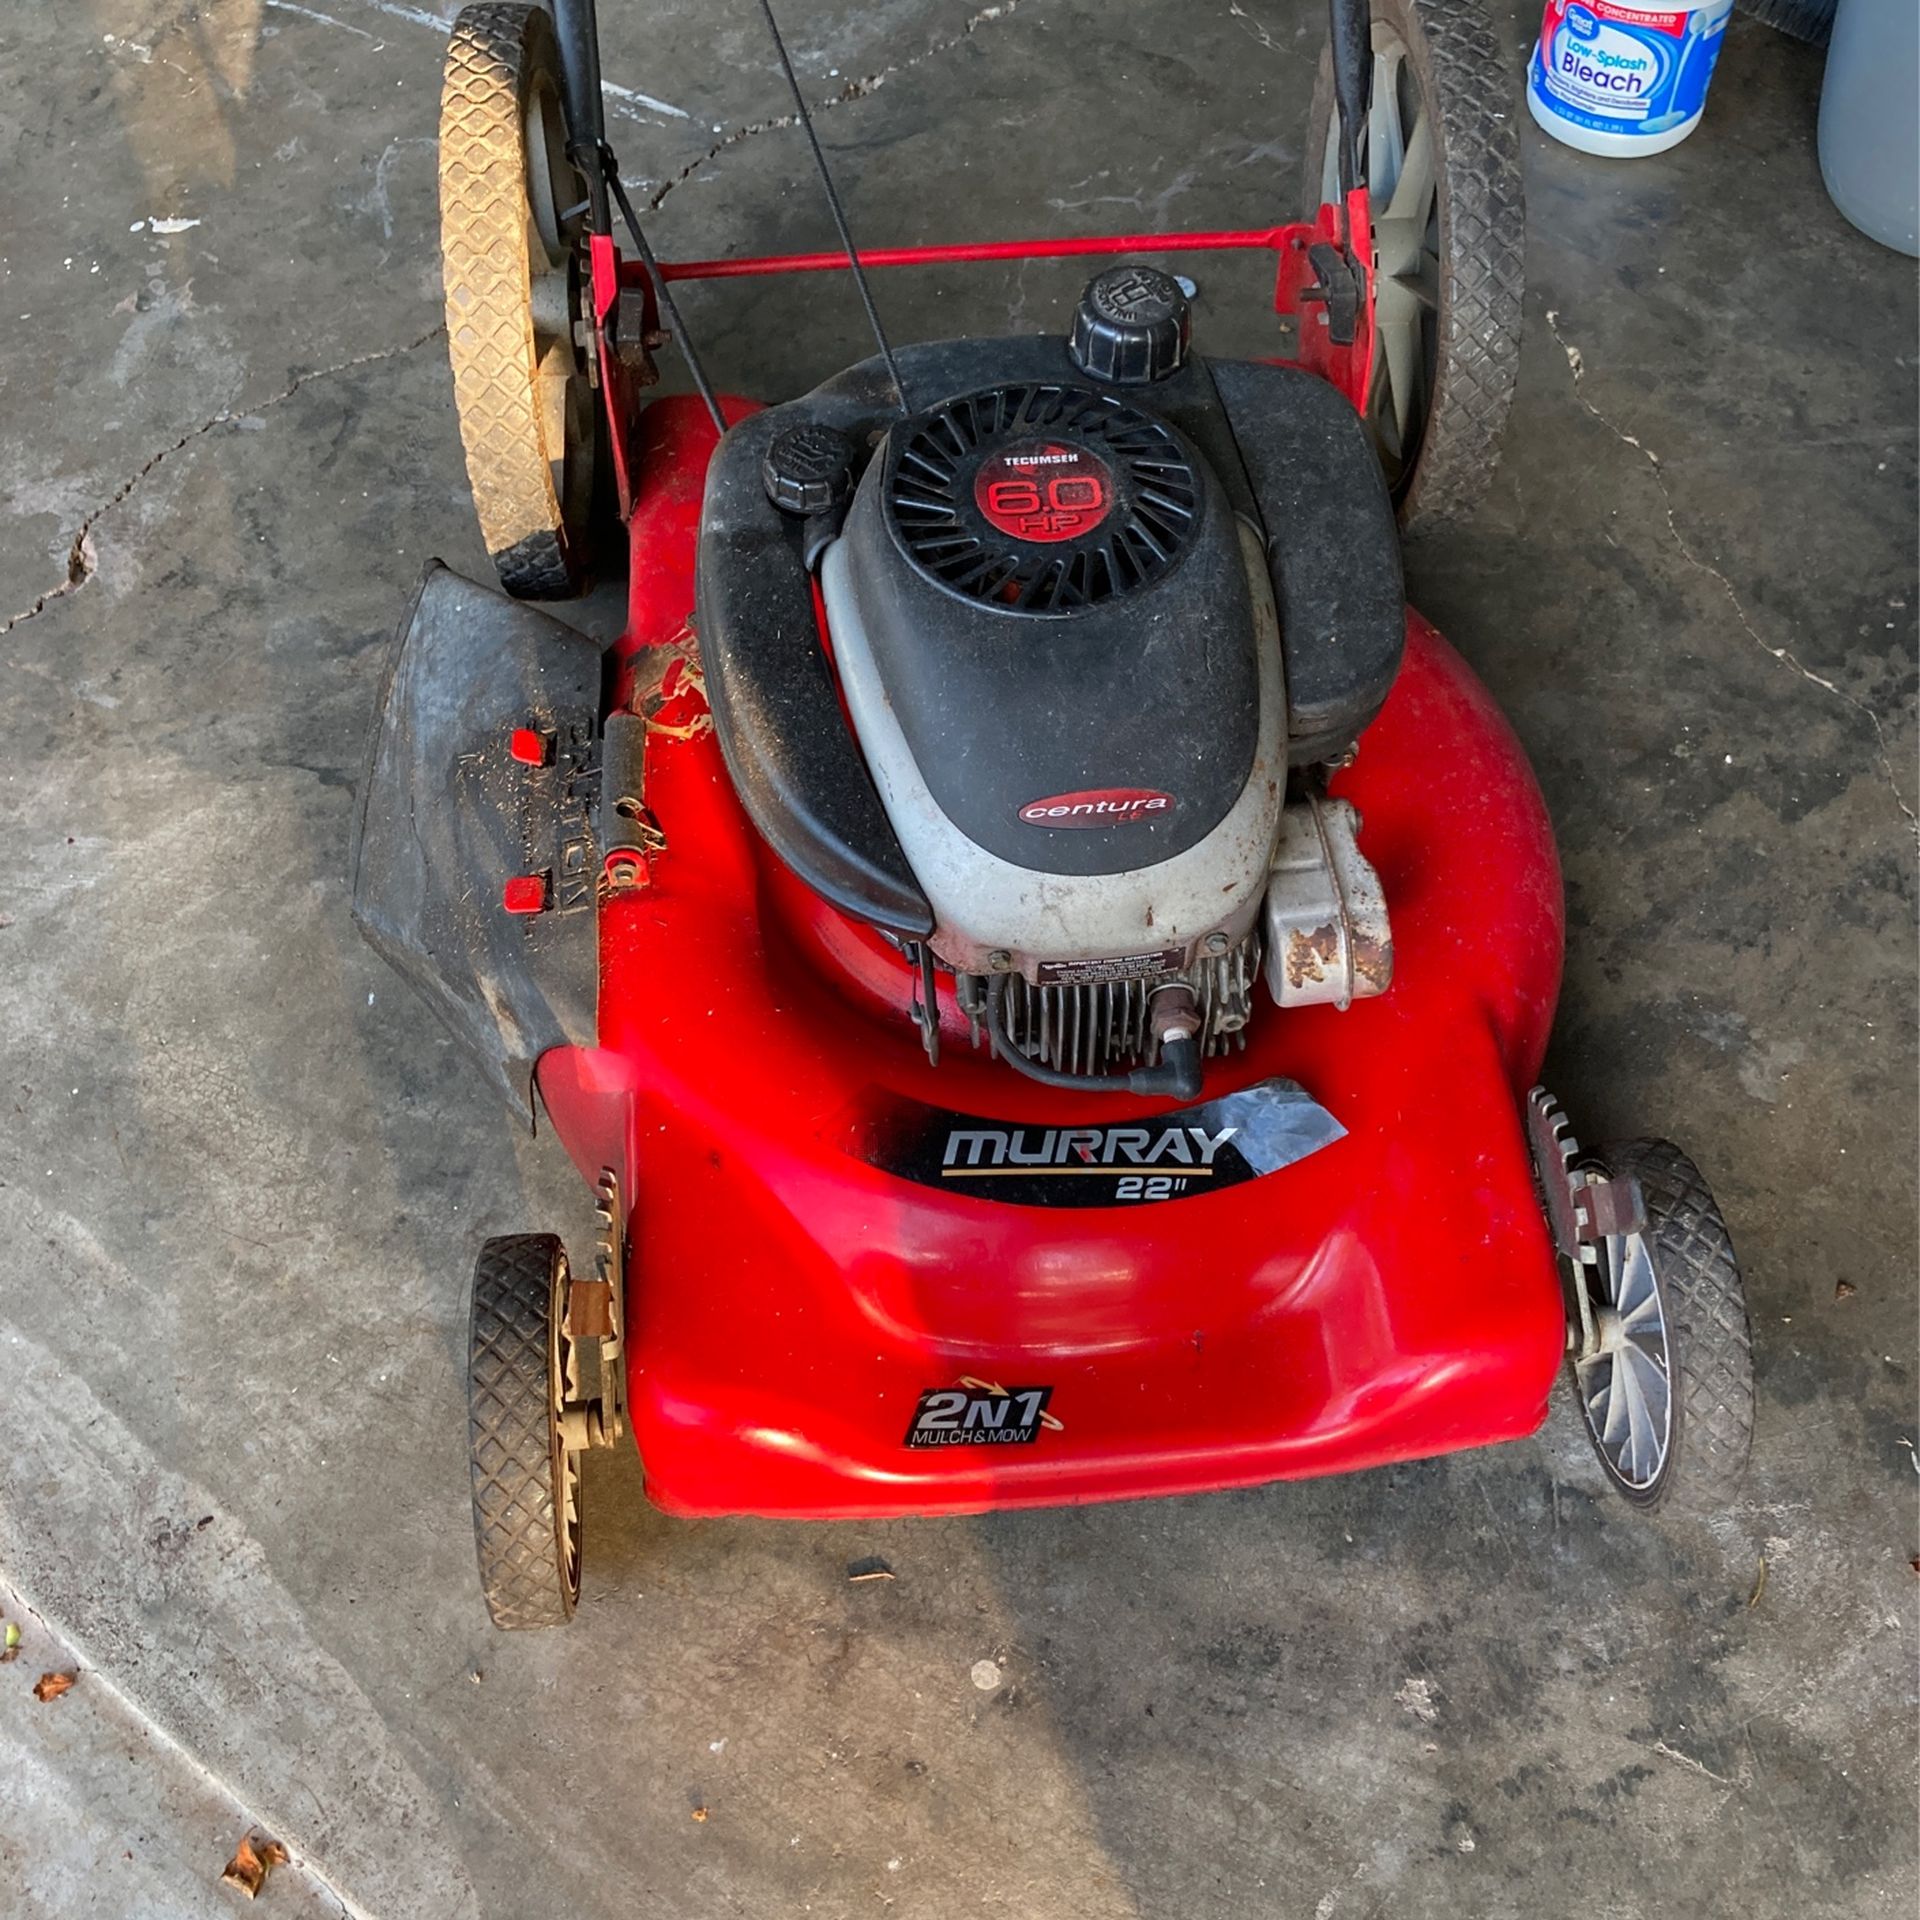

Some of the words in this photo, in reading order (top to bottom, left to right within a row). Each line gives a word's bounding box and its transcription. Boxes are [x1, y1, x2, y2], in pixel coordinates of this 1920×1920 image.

[1567, 8, 1593, 29] Great
[1597, 3, 1676, 25] CONCENTRATED
[1566, 38, 1647, 71] Low-Splash
[1562, 52, 1642, 93] Bleach
[1003, 453, 1079, 466] TECUMSEH
[987, 476, 1104, 516] 6.0
[1018, 515, 1083, 534] HP
[1026, 797, 1167, 819] centura
[942, 1127, 1238, 1166] MURRAY
[1115, 1176, 1187, 1200] 22"
[916, 1390, 1044, 1430] 2N1
